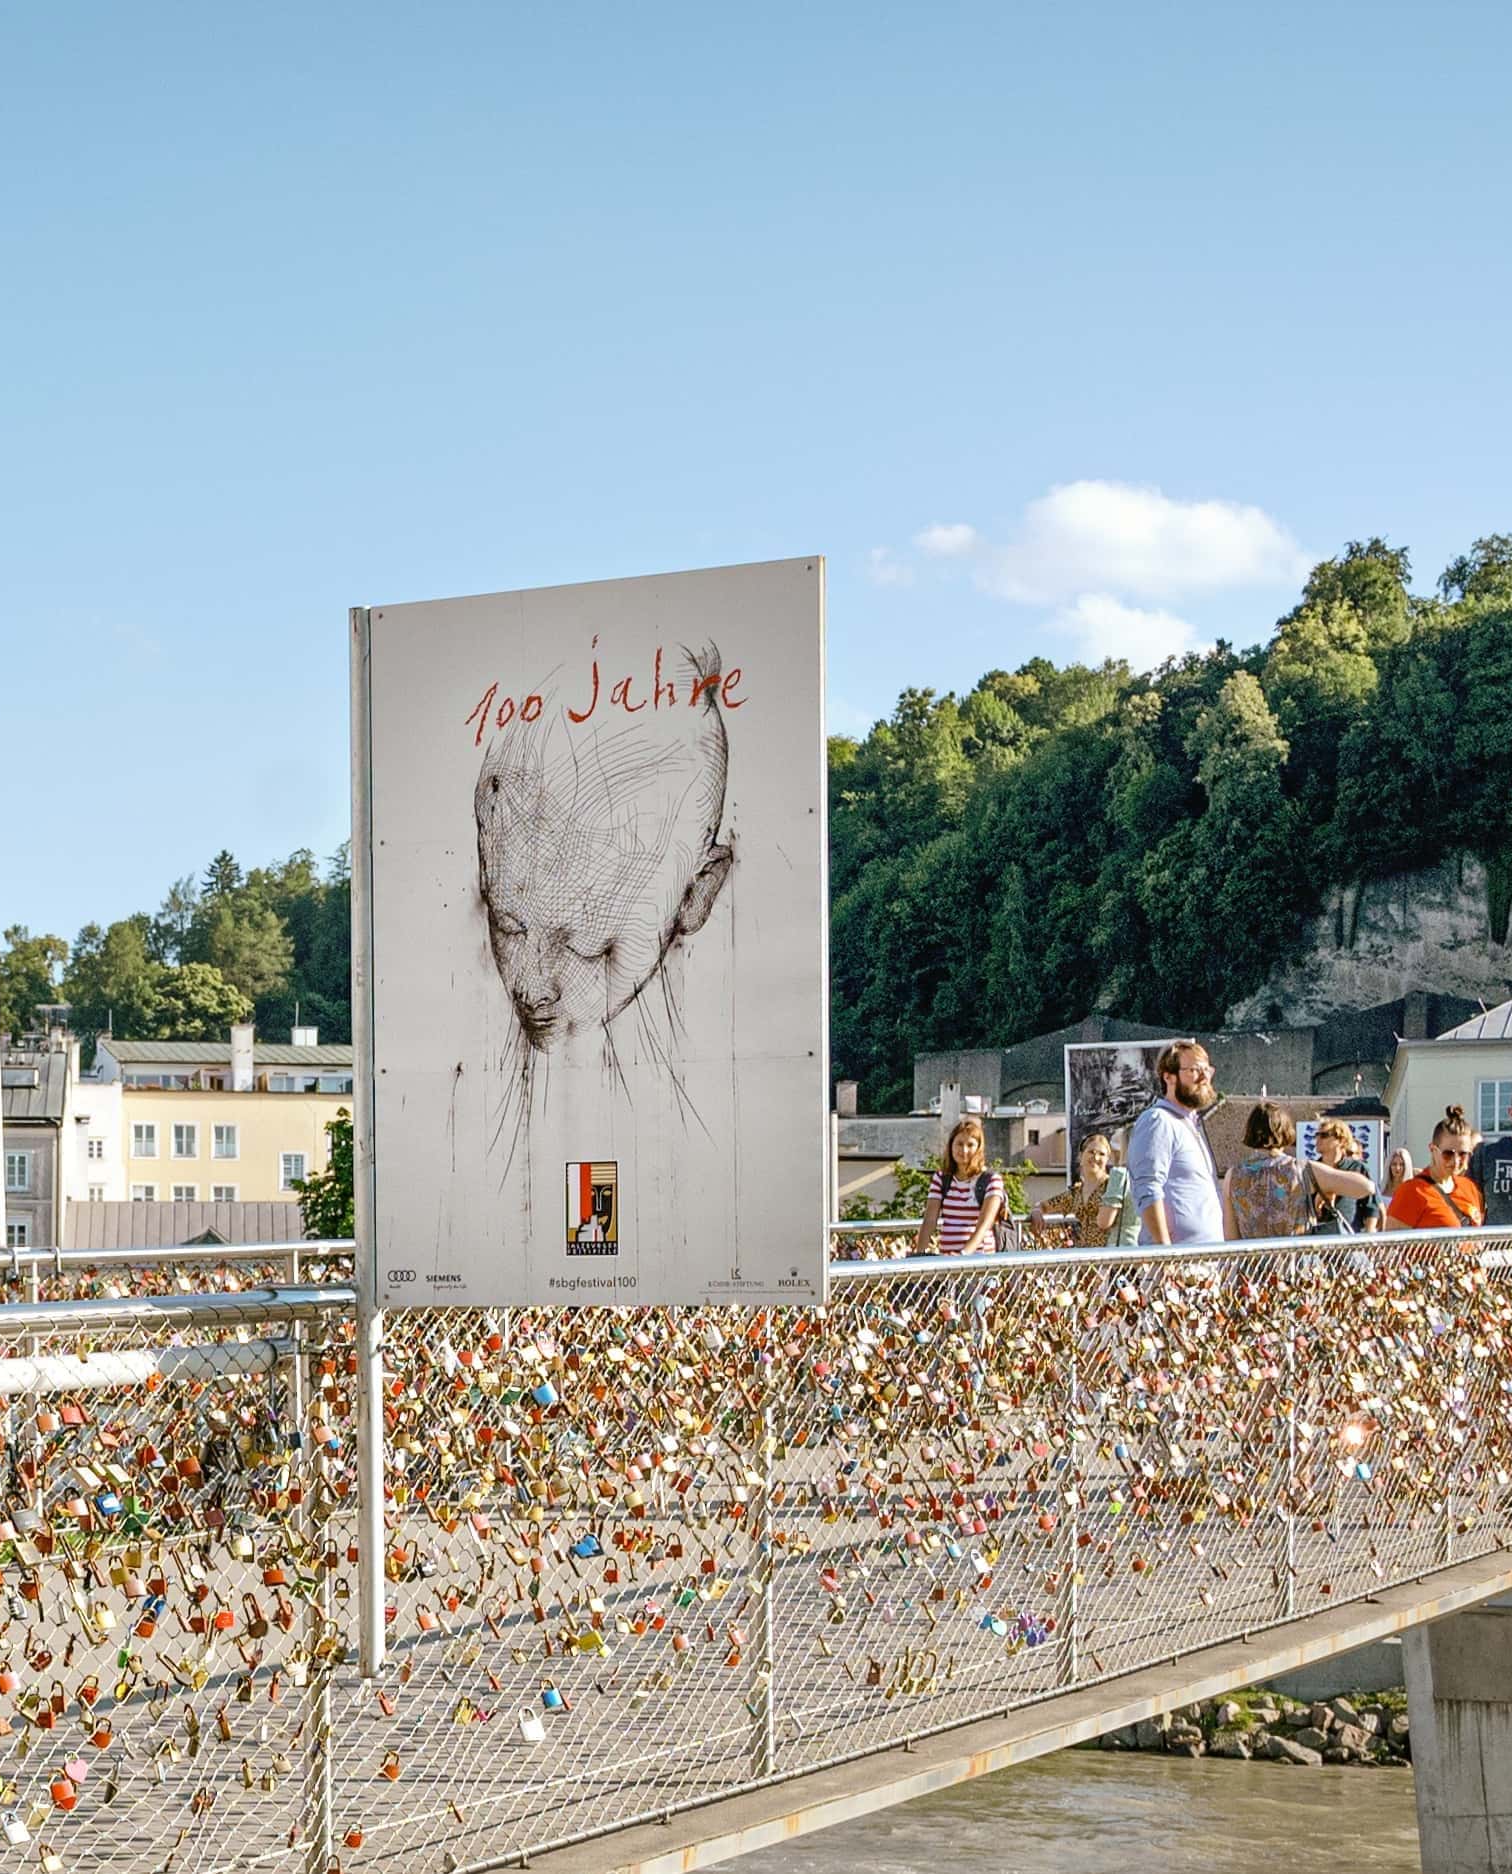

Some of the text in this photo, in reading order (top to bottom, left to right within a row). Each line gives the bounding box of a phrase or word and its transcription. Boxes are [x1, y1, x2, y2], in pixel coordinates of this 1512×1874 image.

[465, 682, 543, 747] 100
[425, 1274, 462, 1283] SIEMENS
[549, 1275, 637, 1291] #sbgfestival100
[778, 1279, 811, 1288] ROLEX
